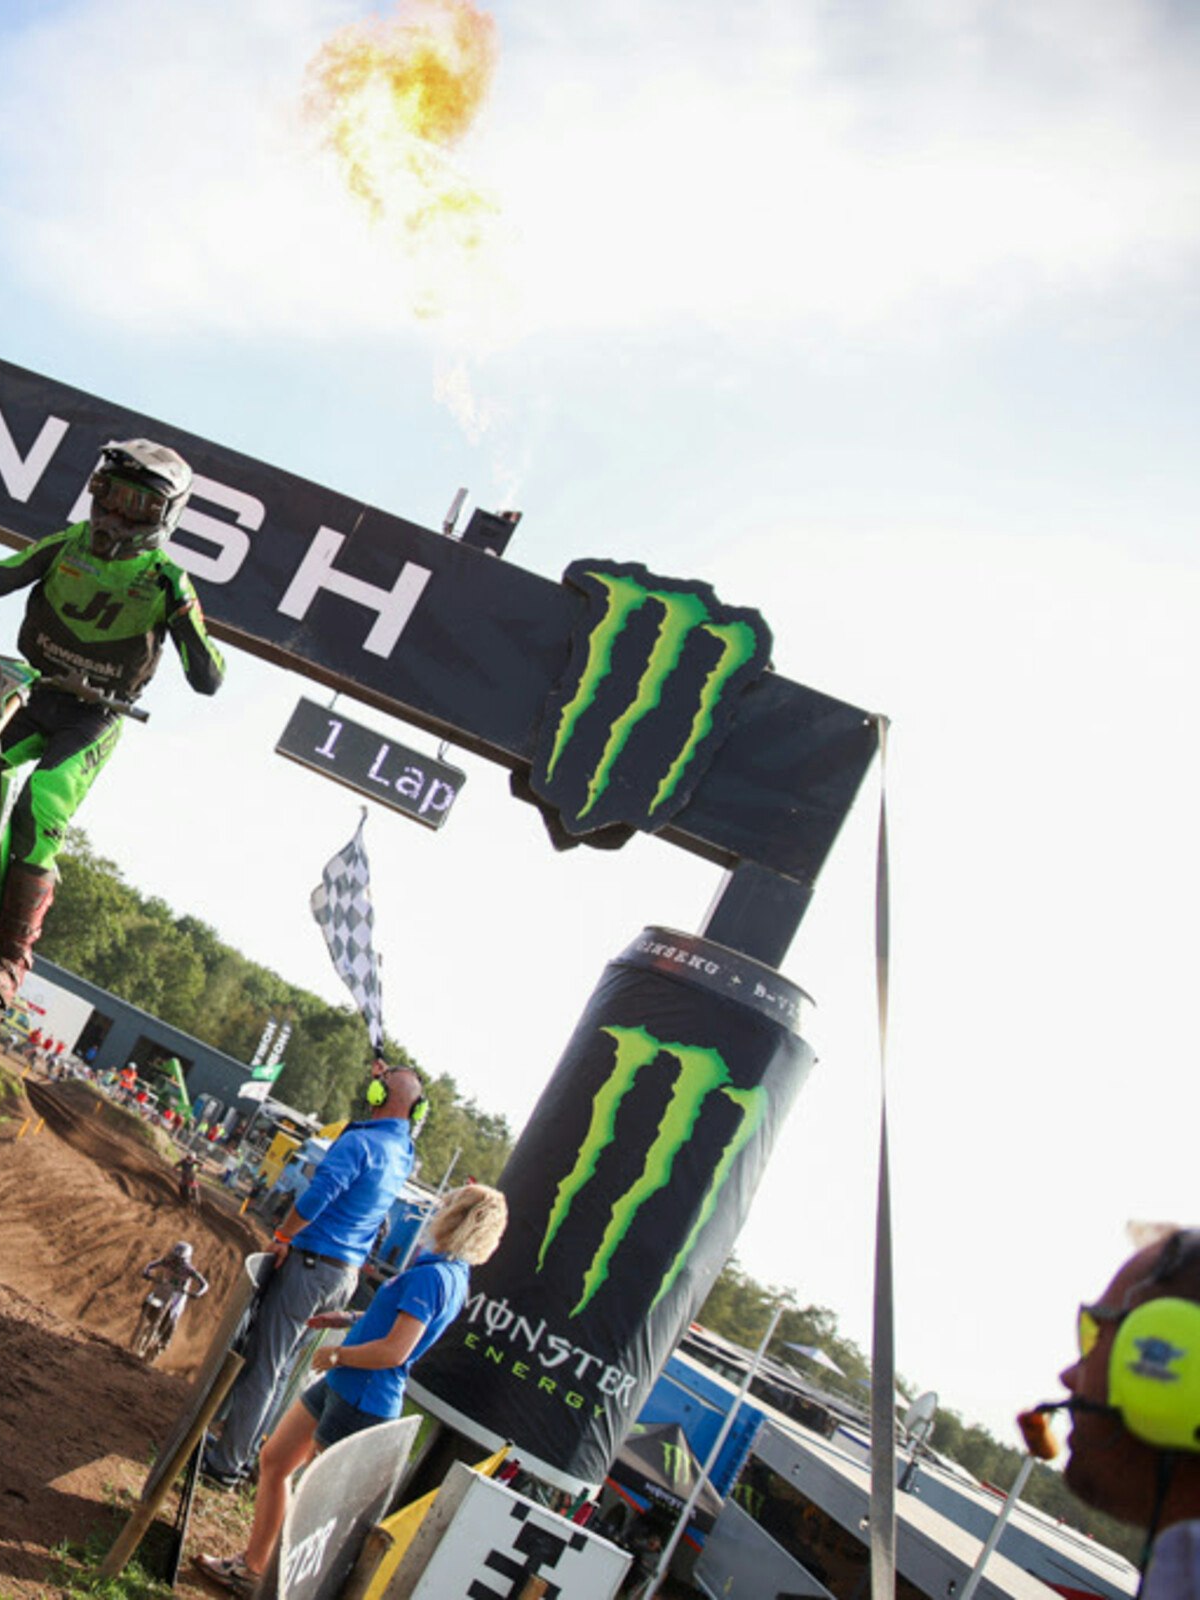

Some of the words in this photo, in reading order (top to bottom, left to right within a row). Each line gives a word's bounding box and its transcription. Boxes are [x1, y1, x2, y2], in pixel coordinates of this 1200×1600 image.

[36, 632, 125, 679] Kawasaki
[314, 719, 344, 760] 1
[367, 743, 455, 814] Lap
[464, 1332, 606, 1419] ENERGY
